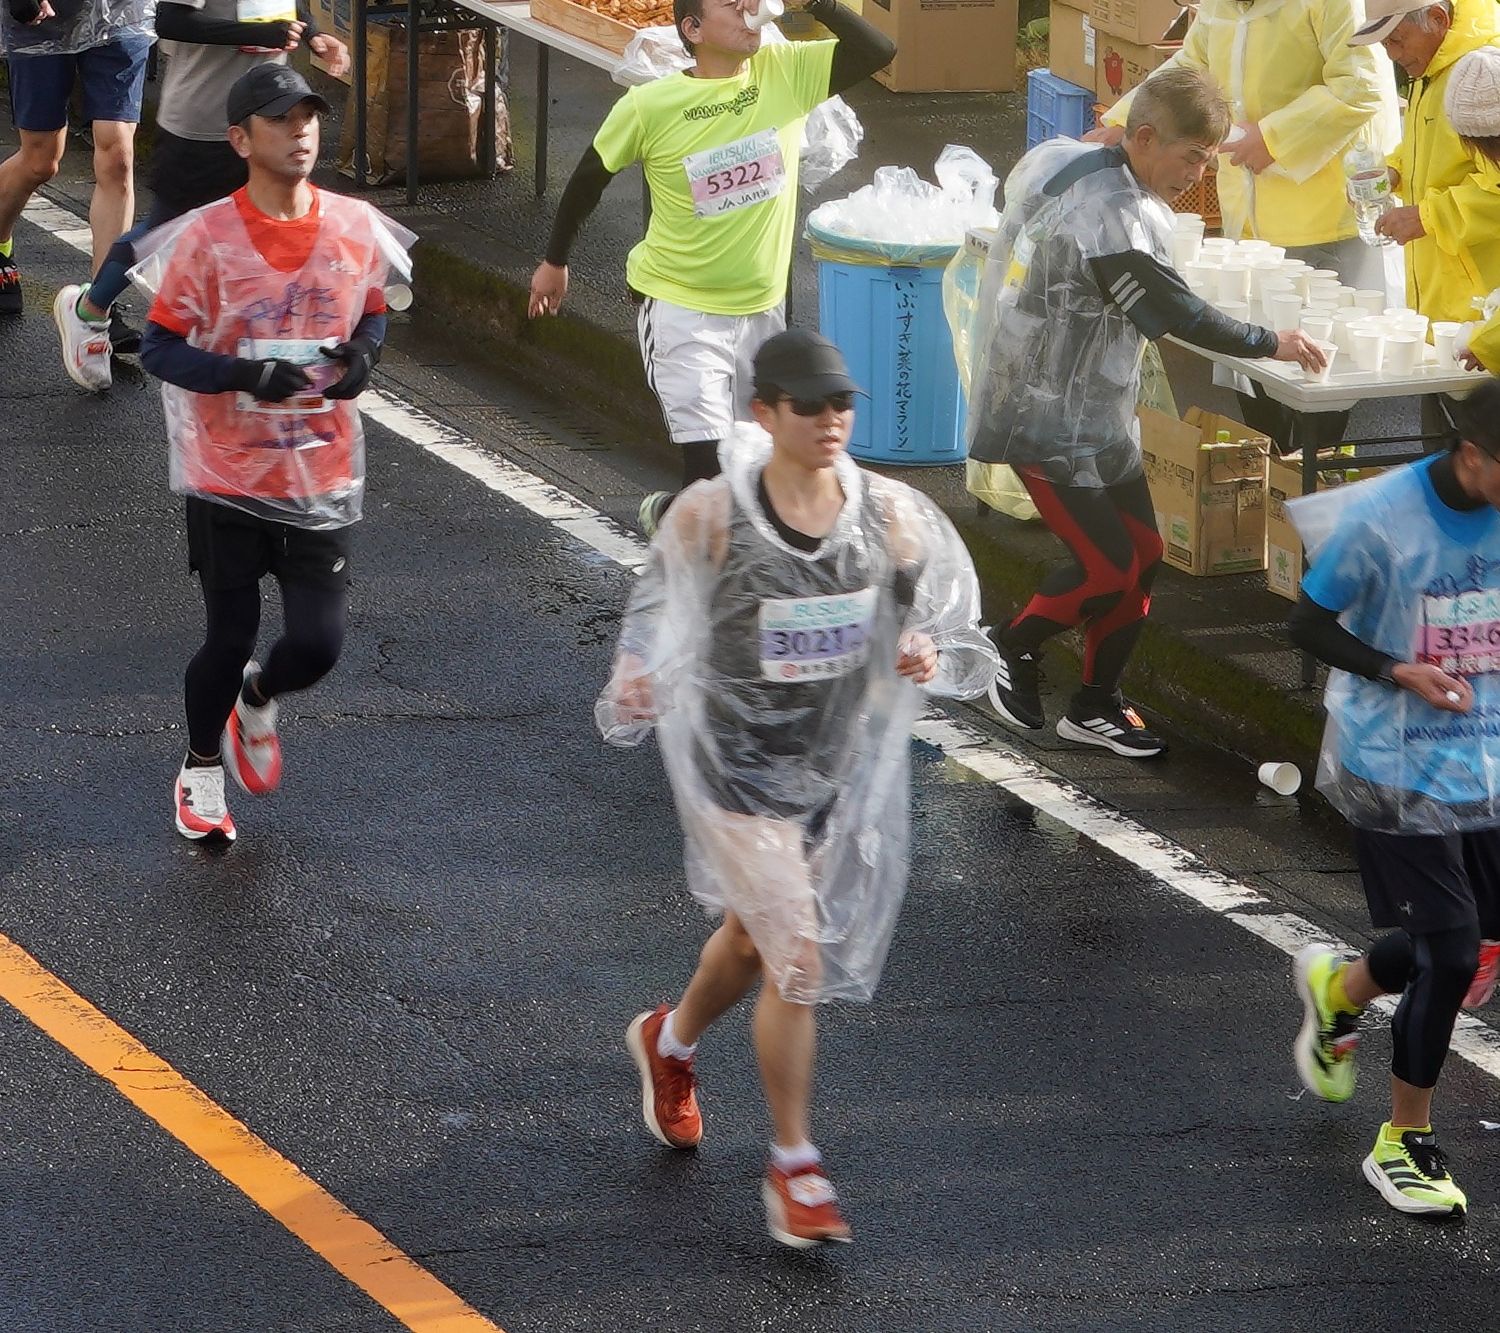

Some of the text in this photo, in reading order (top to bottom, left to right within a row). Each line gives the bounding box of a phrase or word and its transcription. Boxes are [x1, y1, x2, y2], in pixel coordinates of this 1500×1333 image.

[707, 141, 756, 166] IBUSUKI
[706, 162, 763, 195] 5322
[894, 281, 918, 448] いぶすき菜の花マラソン
